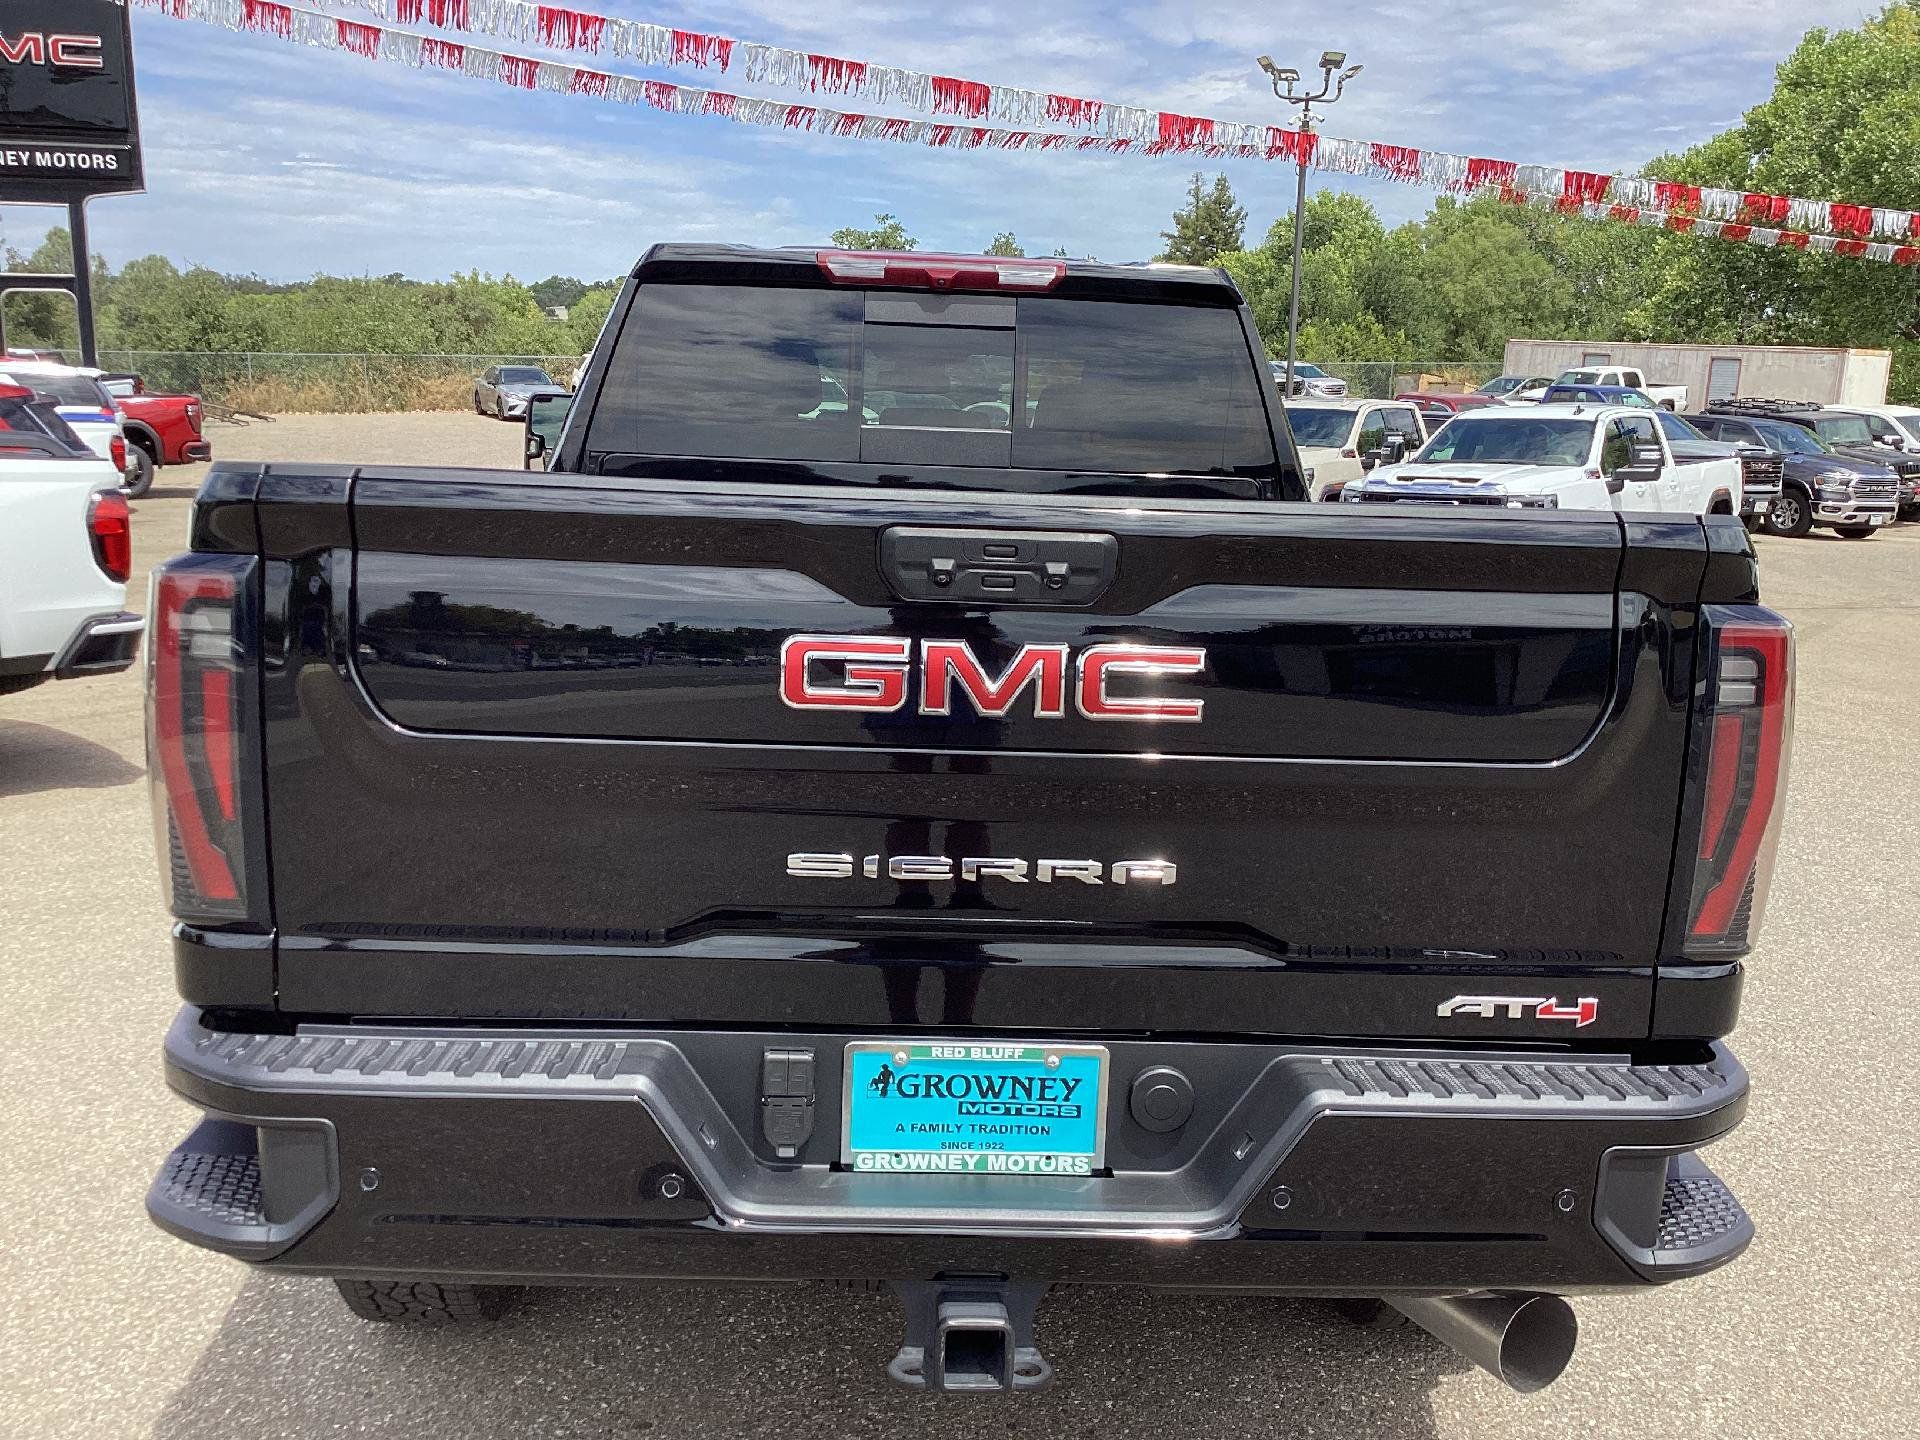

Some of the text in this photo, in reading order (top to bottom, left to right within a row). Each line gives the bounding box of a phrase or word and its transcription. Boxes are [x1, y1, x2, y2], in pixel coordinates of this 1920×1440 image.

[36, 151, 118, 170] MOTORS
[780, 633, 1207, 723] GMC
[786, 852, 1177, 886] SIERRA
[1437, 994, 1599, 1029] AT4
[931, 1047, 1025, 1060] RED BLUFF
[896, 1073, 1083, 1103] GROWNEY
[961, 1102, 1078, 1118] MOTORS
[895, 1123, 1051, 1136] A FAMILY TRADITION
[940, 1141, 1005, 1150] SINCE 1922
[856, 1153, 1090, 1173] GROWNEY MOTORS
